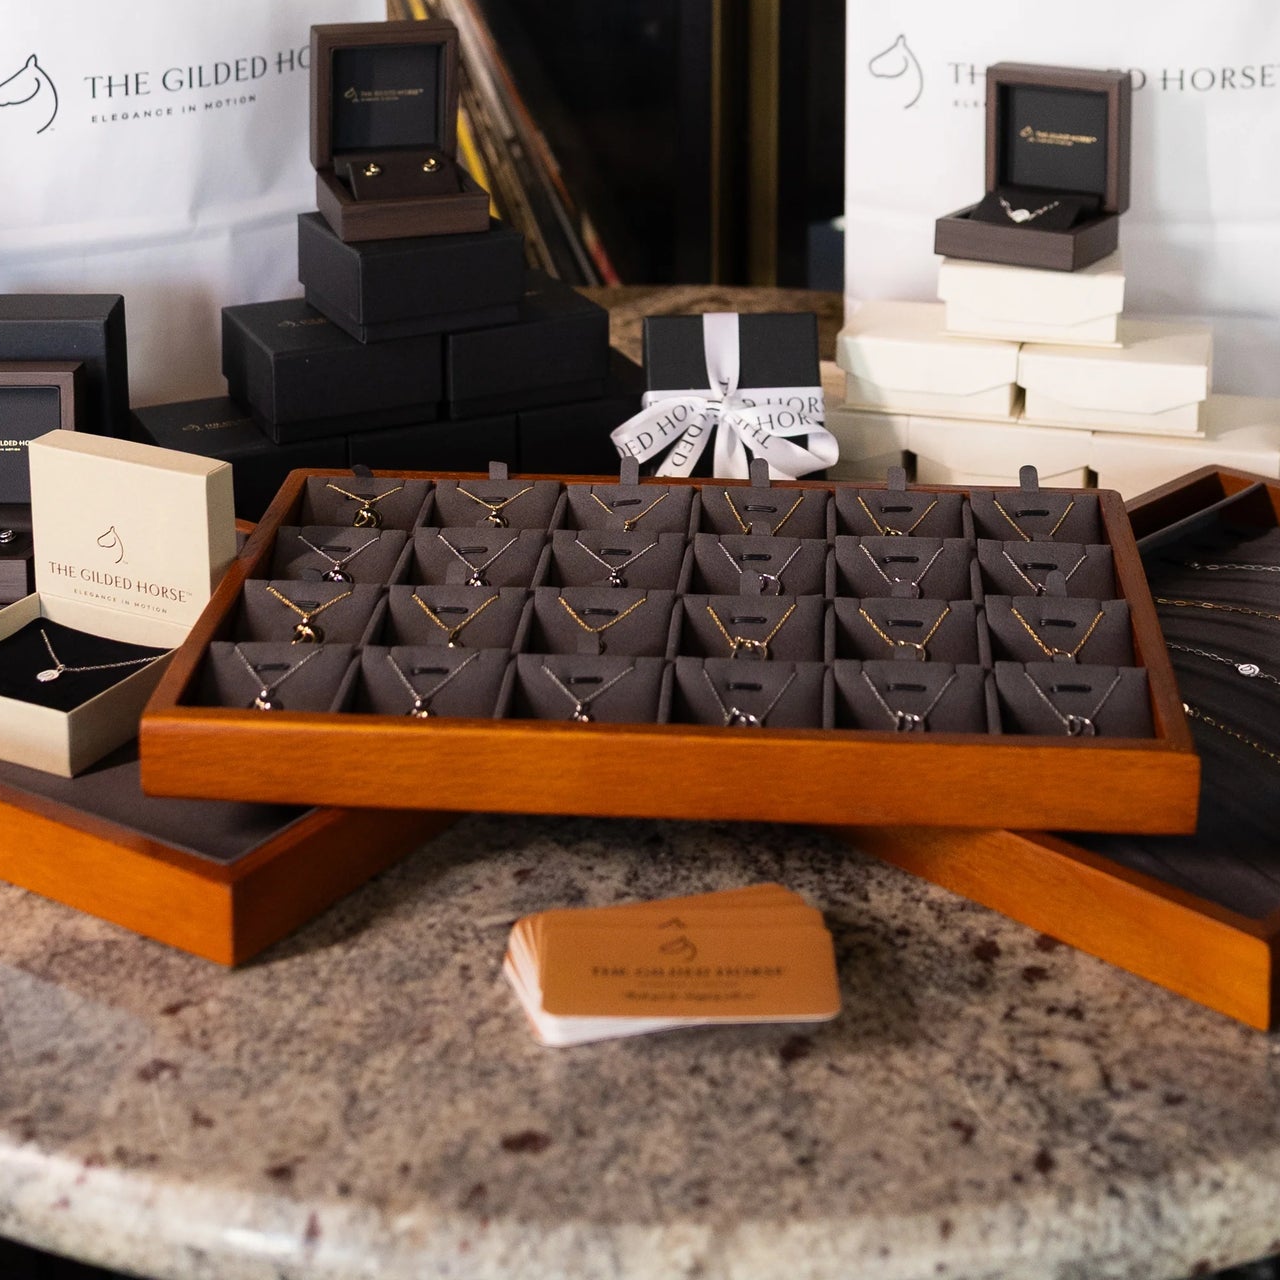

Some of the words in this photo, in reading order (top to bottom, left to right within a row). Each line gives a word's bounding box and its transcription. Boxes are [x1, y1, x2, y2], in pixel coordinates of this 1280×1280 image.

[83, 71, 151, 99] THE
[161, 54, 268, 93] GILDED
[1158, 64, 1277, 93] HORSE
[91, 106, 173, 124] ELEGANCE
[182, 104, 197, 114] IN
[204, 93, 257, 111] MOTION
[48, 561, 78, 579] THE
[80, 568, 132, 591] GILDED
[136, 580, 188, 604] HORSE
[73, 588, 117, 603] ELEGANCE
[134, 602, 168, 614] MOTION
